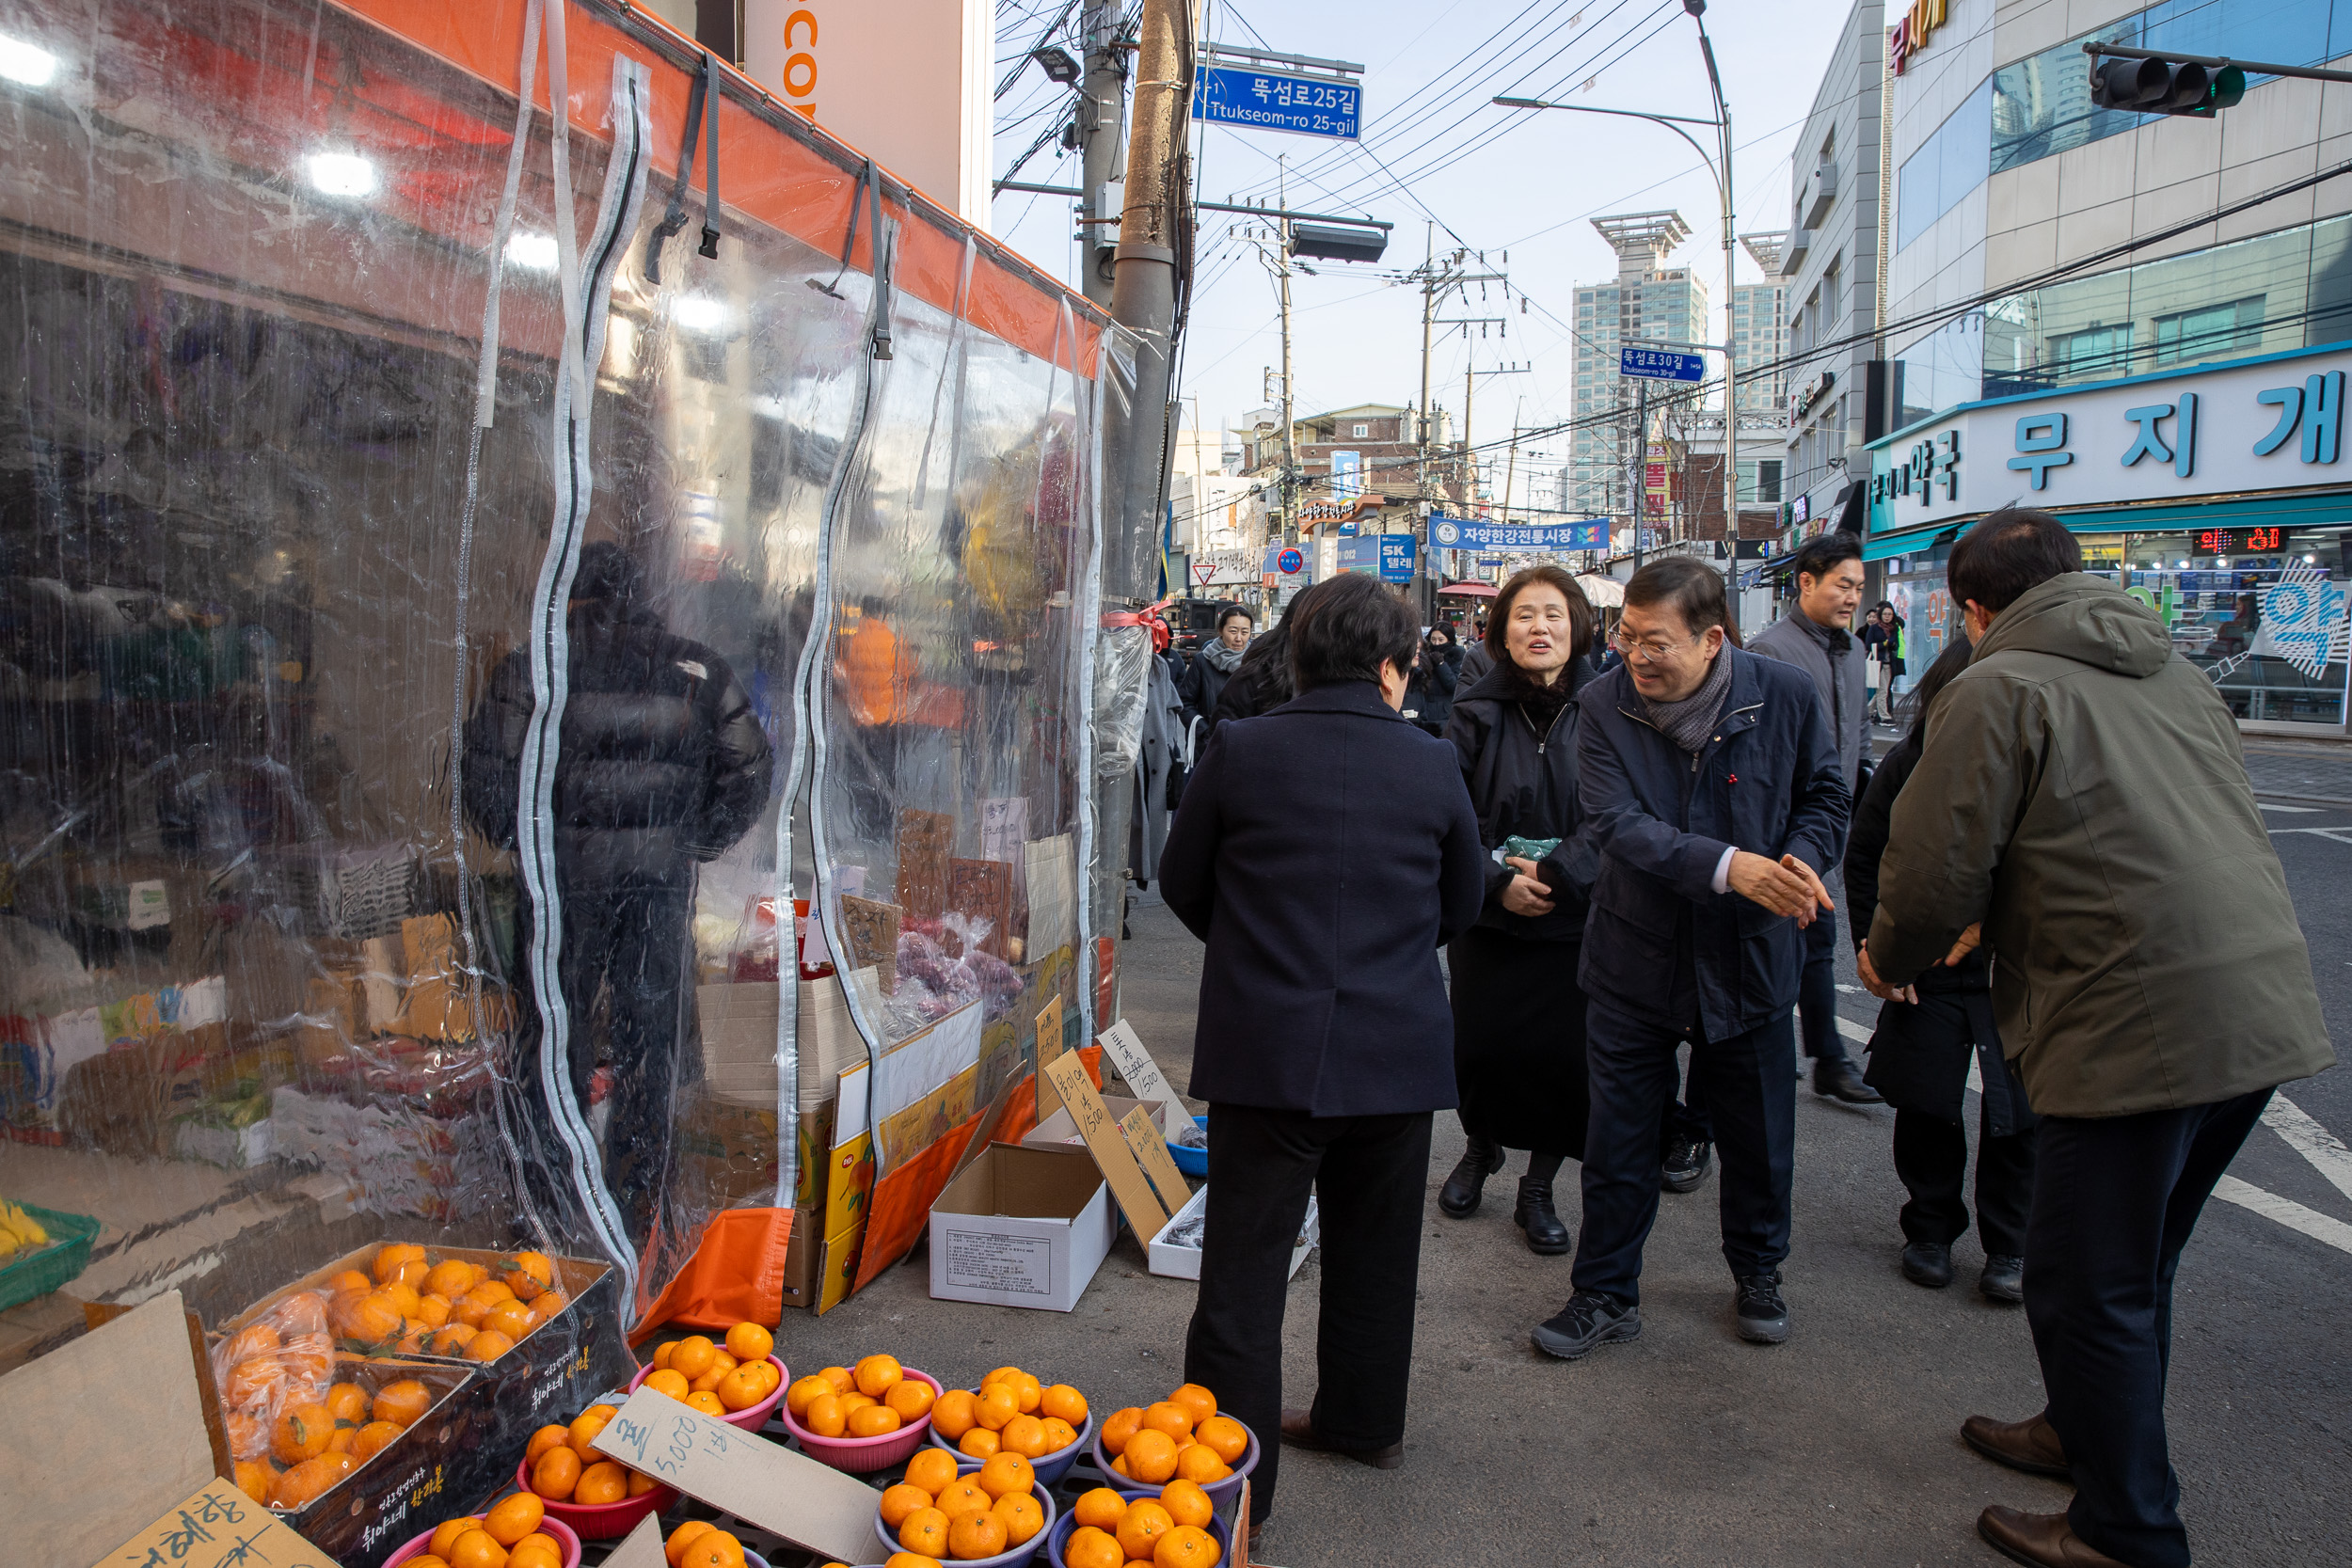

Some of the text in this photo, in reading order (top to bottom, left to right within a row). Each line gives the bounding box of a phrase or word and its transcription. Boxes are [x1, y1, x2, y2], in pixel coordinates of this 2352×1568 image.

[1251, 77, 1356, 116] 뚝섬로25길
[1210, 101, 1355, 135] Ttukseom-ro 25-gil
[1623, 350, 1683, 371] 뚝섬로30길
[1623, 365, 1677, 378] Ttukseom-ro 30-gil
[2006, 370, 2346, 491] 무지개
[1382, 545, 1405, 556] SK
[1464, 527, 1572, 545] 자양한강전통시장
[1323, 541, 1333, 580] 자양한강
[1387, 557, 1416, 569] 텔레
[1056, 1066, 1089, 1101] 물미역
[410, 1464, 444, 1508] 한라봉
